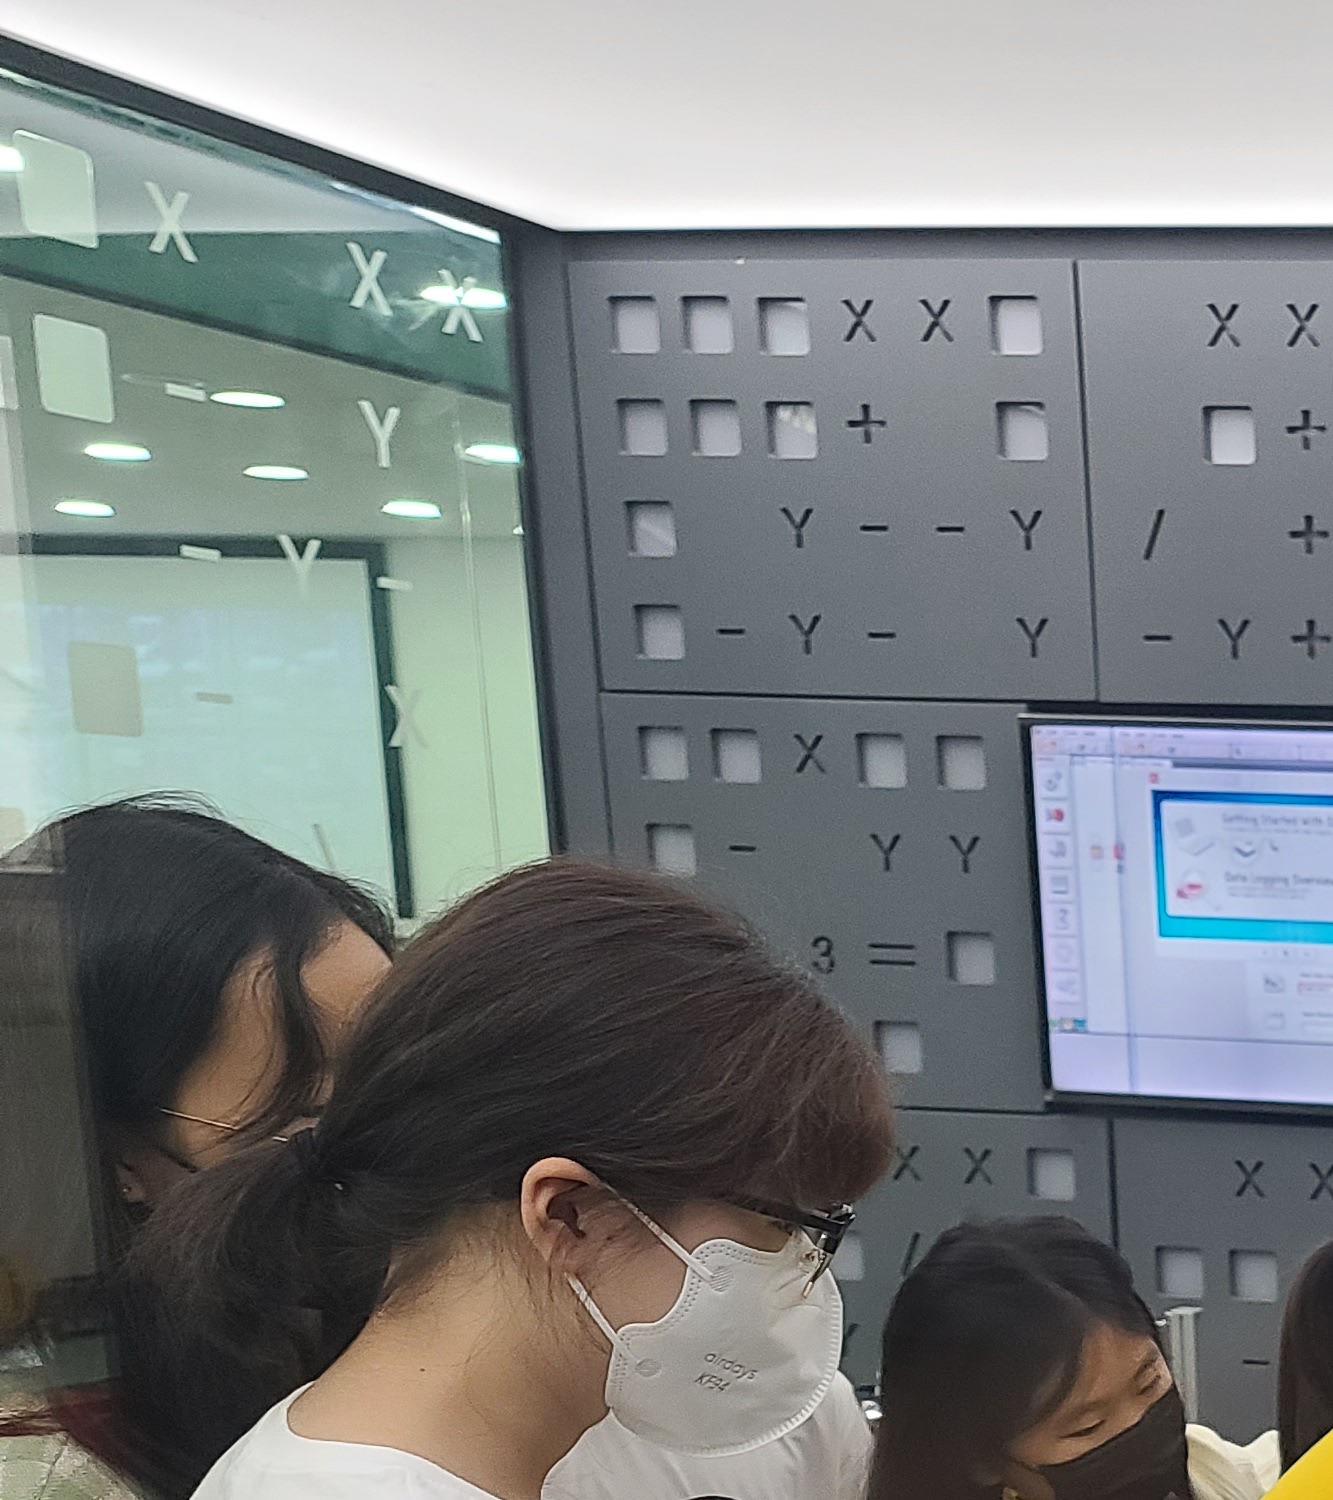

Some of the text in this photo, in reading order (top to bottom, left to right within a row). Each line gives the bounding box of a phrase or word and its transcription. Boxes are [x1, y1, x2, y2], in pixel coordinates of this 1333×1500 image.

[842, 299, 953, 342] X X
[1207, 304, 1319, 347] X X
[781, 508, 813, 548] Y
[1010, 510, 1042, 550] Y
[789, 614, 821, 654] Y
[1016, 618, 1048, 658] Y
[1218, 619, 1250, 659] Y
[794, 734, 825, 773] X
[870, 834, 901, 871] Y
[949, 835, 980, 873] Y
[812, 936, 835, 974] 3
[894, 1145, 992, 1184] X X
[1235, 1160, 1264, 1197] X
